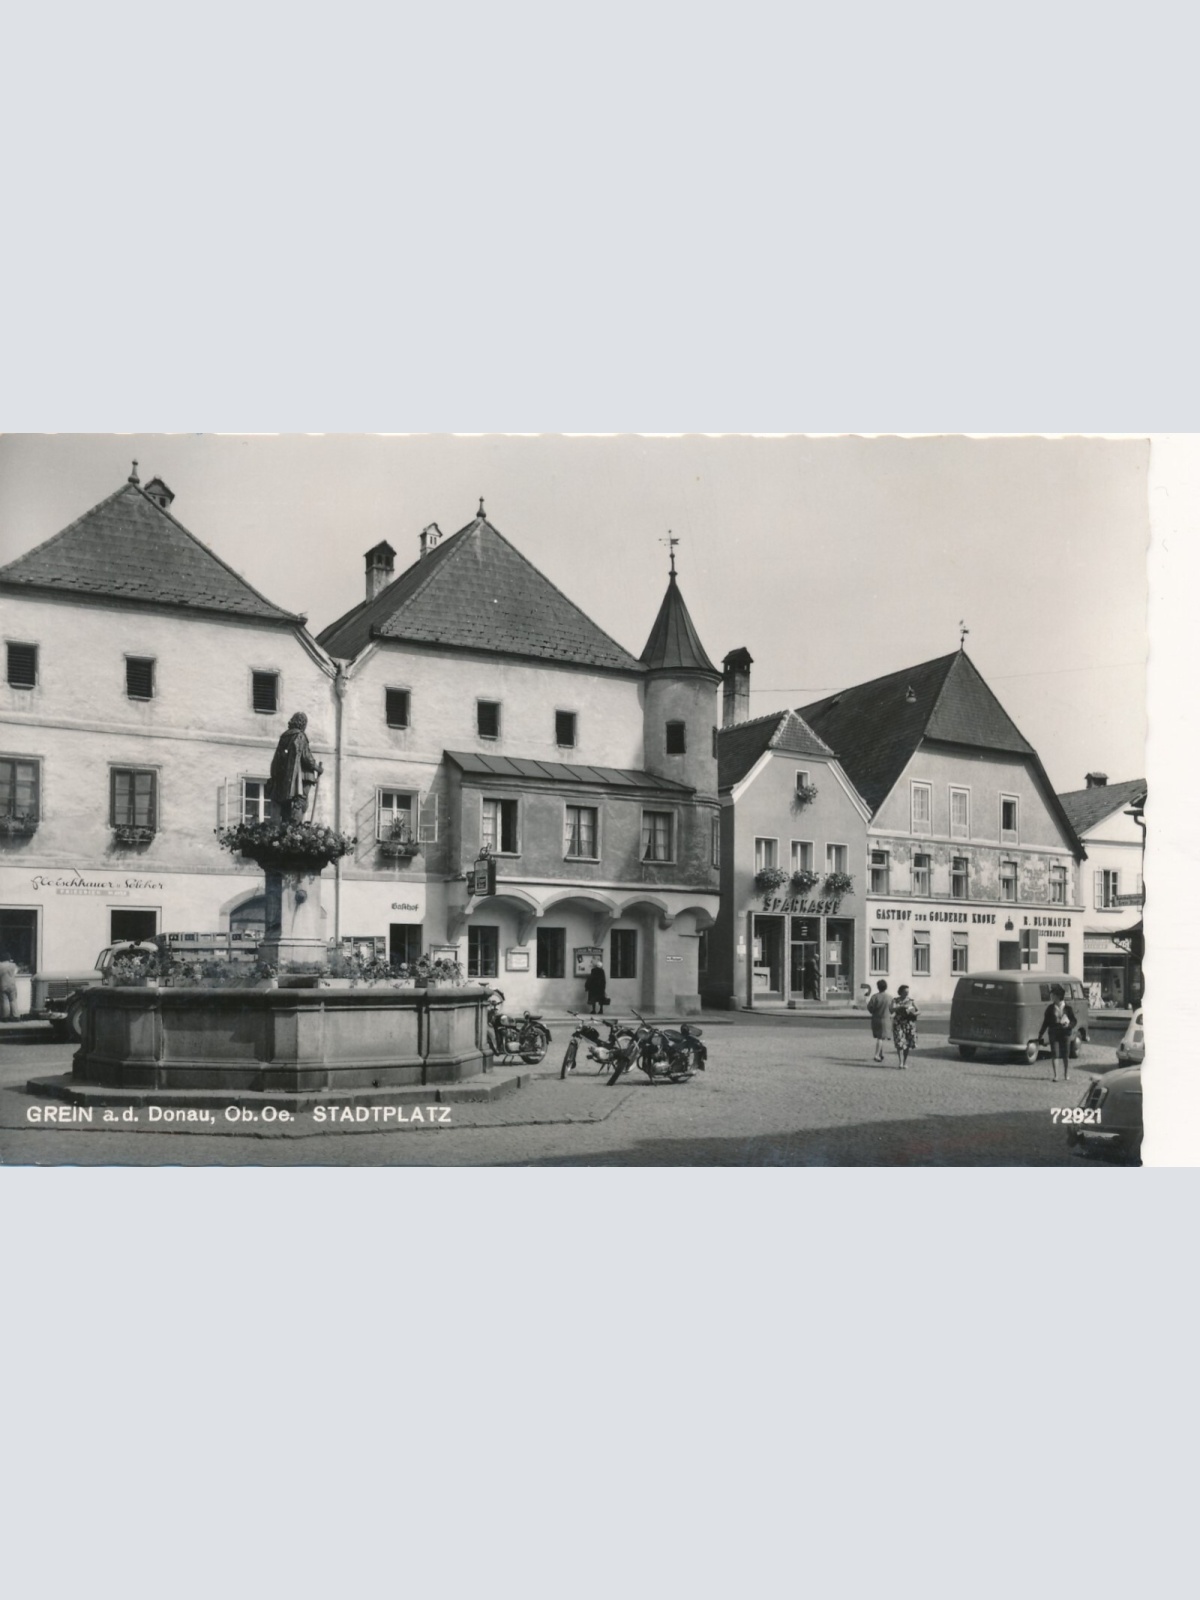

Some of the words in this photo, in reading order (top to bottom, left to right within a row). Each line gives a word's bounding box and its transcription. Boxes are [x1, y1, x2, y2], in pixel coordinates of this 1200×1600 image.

[391, 902, 419, 911] Gasthof
[763, 898, 840, 915] SPARKASSE
[876, 908, 912, 921] GASTHOF
[971, 913, 996, 924] KRONE
[1033, 916, 1072, 927] BLUMAUER
